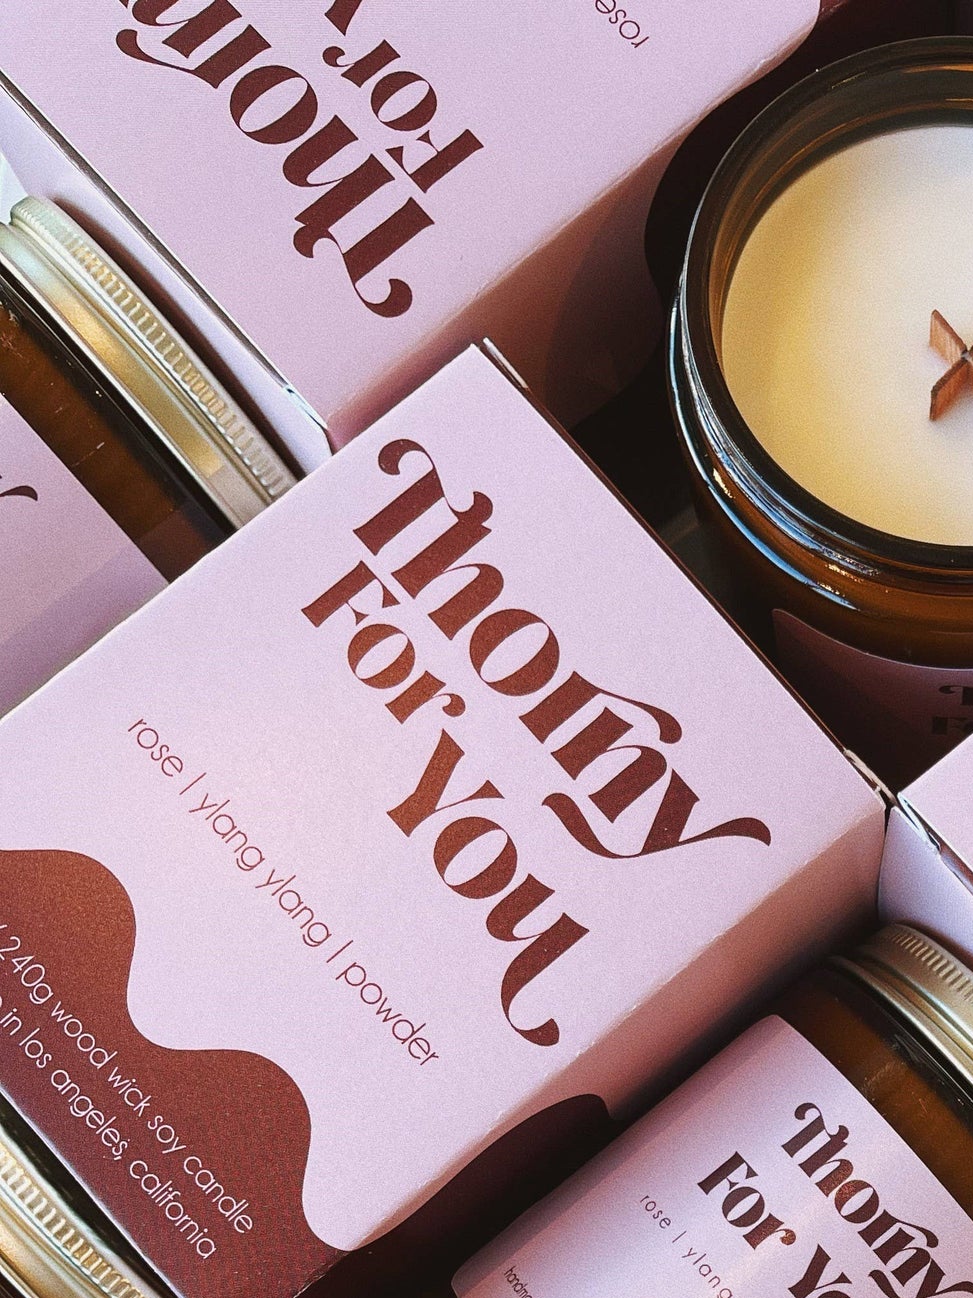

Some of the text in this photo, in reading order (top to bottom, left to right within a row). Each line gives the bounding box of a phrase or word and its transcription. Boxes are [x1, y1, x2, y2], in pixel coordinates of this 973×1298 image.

[116, 0, 435, 318] Thorn
[323, 39, 484, 193] For
[353, 439, 771, 858] Thorny
[127, 718, 439, 1066] rose ylang ylang powder
[301, 560, 590, 1047] For You
[0, 935, 253, 1233] 240g wood wick soy candle
[0, 1007, 216, 1259] in los angeles, california
[640, 1195, 671, 1229] rose
[697, 1151, 796, 1251] For
